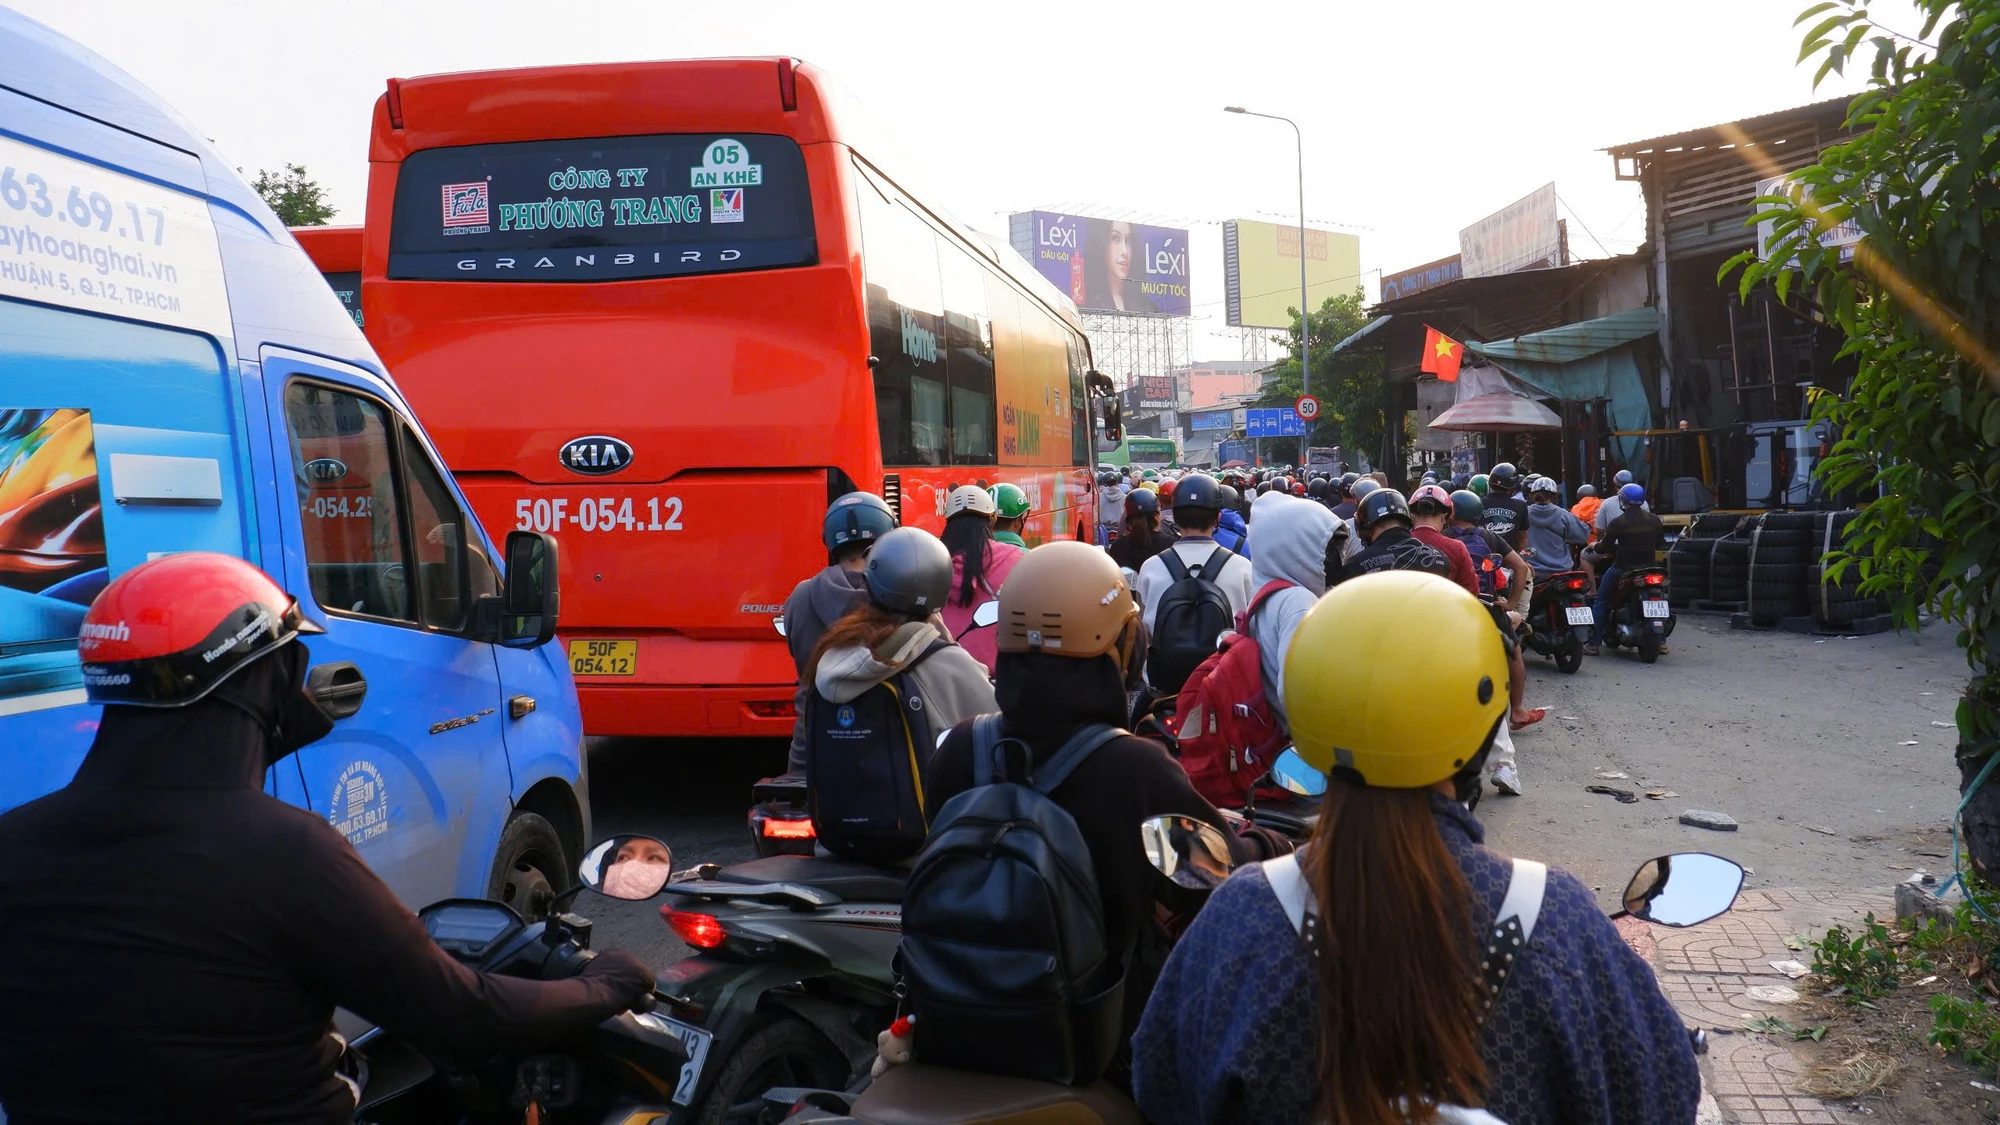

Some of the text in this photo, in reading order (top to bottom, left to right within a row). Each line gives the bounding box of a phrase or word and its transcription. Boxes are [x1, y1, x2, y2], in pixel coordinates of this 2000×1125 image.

[712, 145, 739, 165] 05
[549, 166, 648, 190] CÔNG TY
[694, 167, 758, 186] AN KHÊ
[499, 195, 702, 231] PHƯƠNG TRANG
[457, 250, 741, 271] GRANBIRD
[59, 273, 76, 296] 5,
[126, 286, 181, 313] TP.HCM
[1143, 376, 1171, 389] NICE
[1144, 387, 1171, 399] CAR
[1303, 402, 1314, 414] 50
[570, 444, 621, 467] KIA
[308, 464, 340, 479] KIA
[516, 496, 683, 532] 50F-054.12
[1483, 507, 1517, 520] LONDON
[202, 637, 238, 663] Honda
[588, 641, 618, 657] 50F
[574, 658, 629, 673] 054.12
